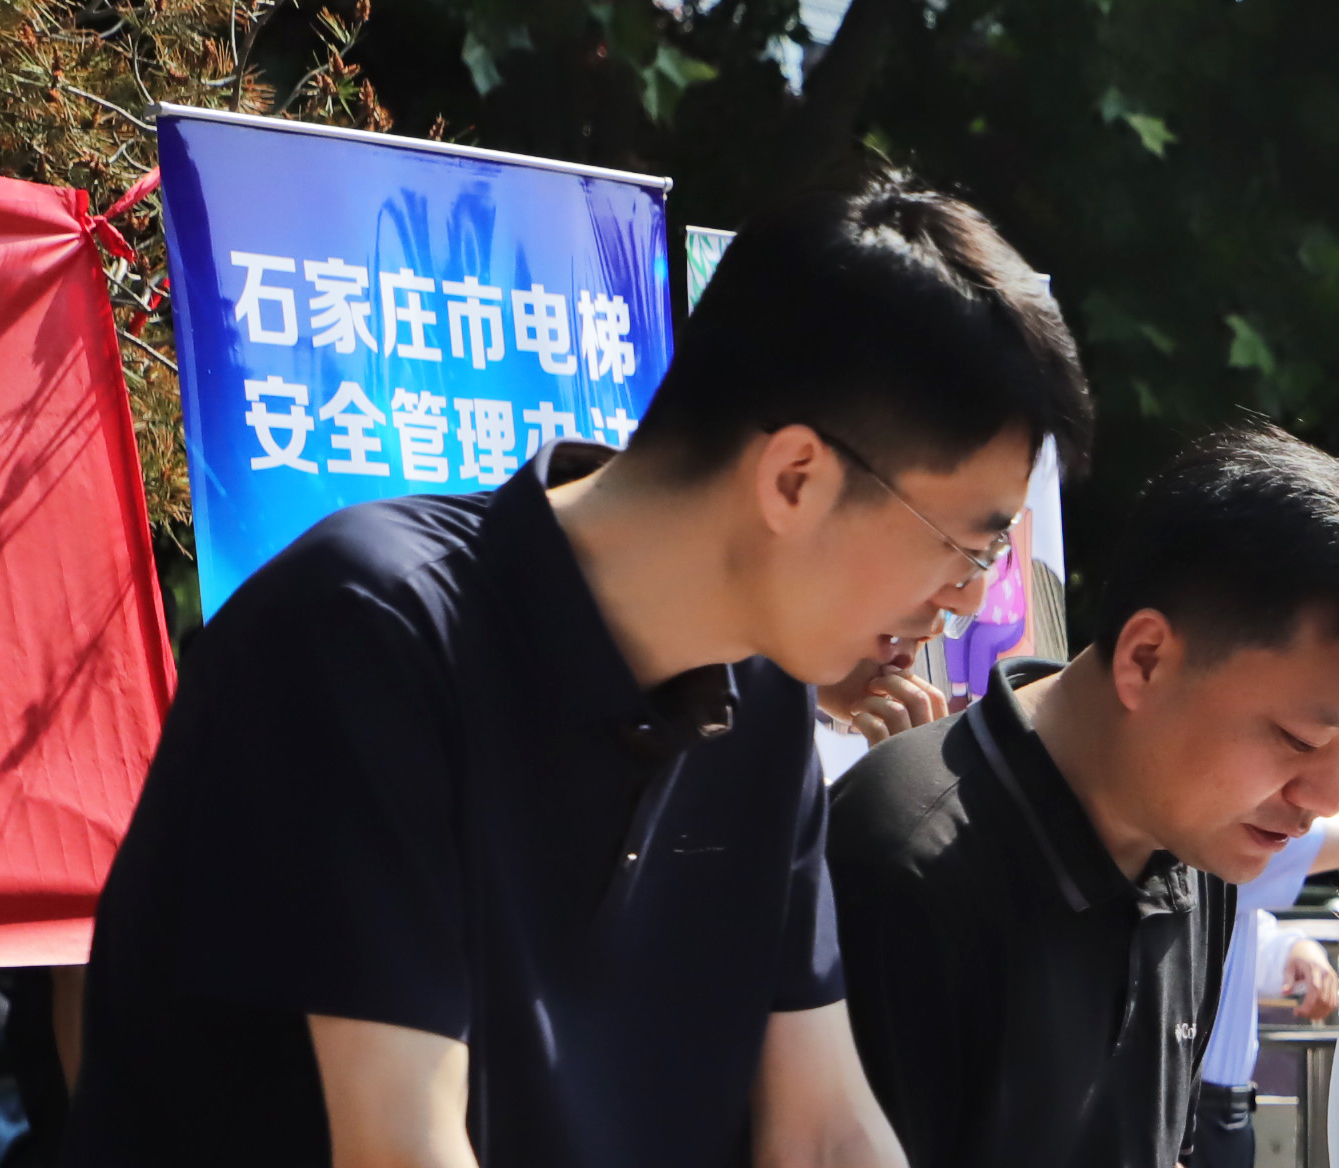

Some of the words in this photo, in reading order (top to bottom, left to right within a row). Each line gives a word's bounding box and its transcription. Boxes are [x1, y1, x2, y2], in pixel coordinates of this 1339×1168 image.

[230, 251, 637, 384] 石家庄市电梯
